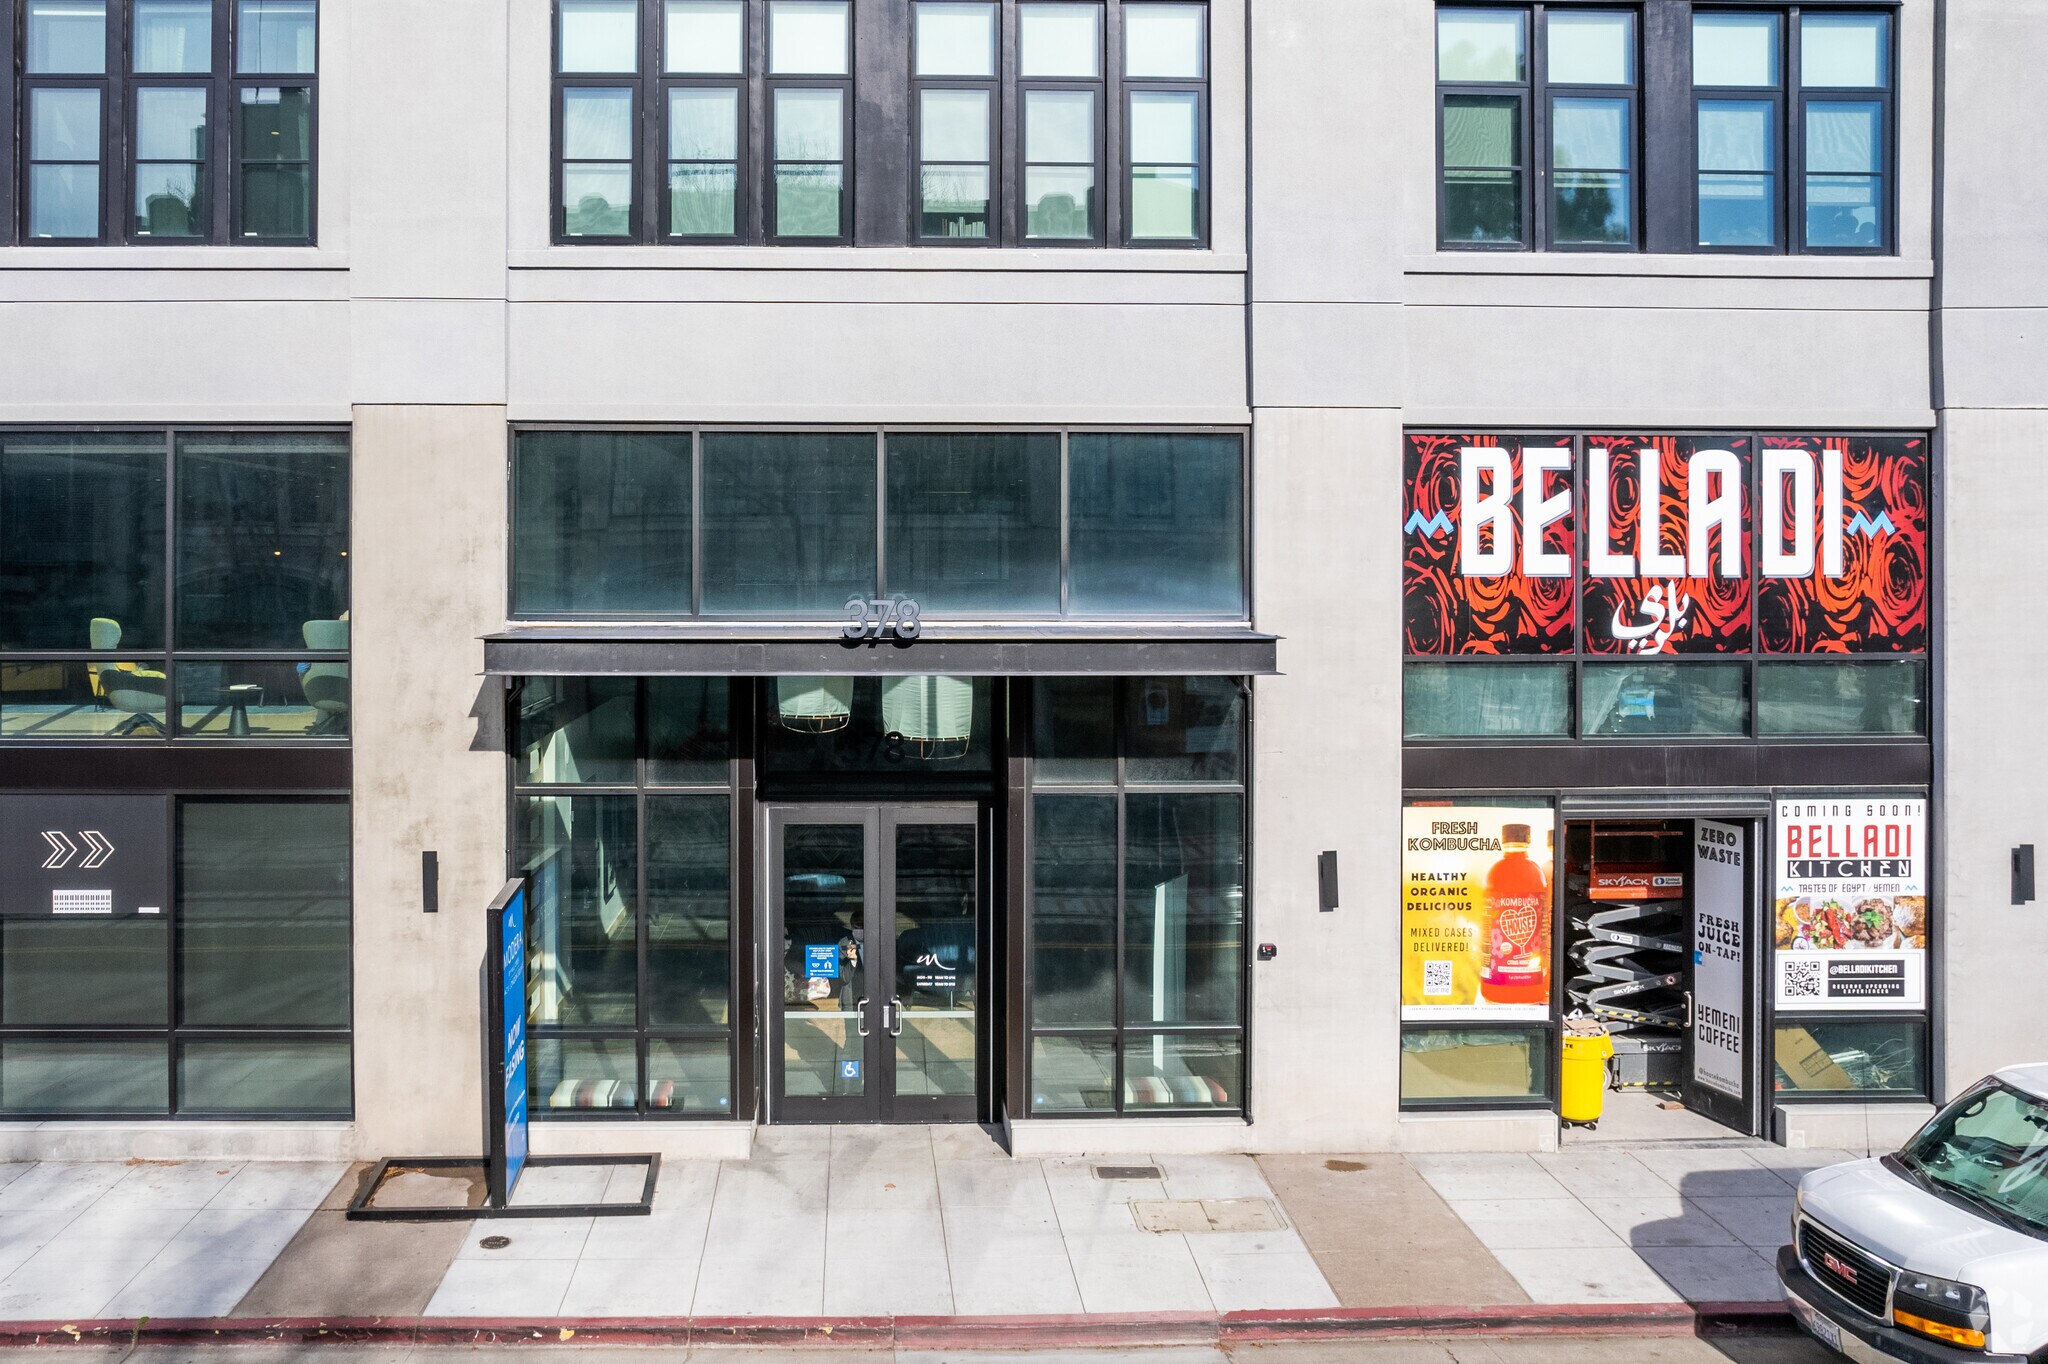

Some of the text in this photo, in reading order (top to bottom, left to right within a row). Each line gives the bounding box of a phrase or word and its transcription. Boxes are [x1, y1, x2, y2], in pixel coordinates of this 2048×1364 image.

[1461, 447, 1843, 577] BELLADI
[843, 599, 921, 639] 378
[1782, 804, 1921, 817] COMING SOON!
[1432, 821, 1478, 835] FRESH
[1700, 827, 1737, 847] ZERO
[1408, 838, 1501, 851] KOMBUCHA
[1787, 824, 1911, 858] BELLADI
[1697, 844, 1740, 867] WASTE
[1411, 872, 1467, 881] HEALTHY
[1789, 861, 1910, 877] KITCHEN
[1598, 876, 1649, 886] SKYJACK
[1799, 884, 1826, 893] TASTES
[1829, 884, 1838, 893] OF
[1842, 884, 1866, 893] EGYPT
[1873, 884, 1900, 893] YEMEN
[1410, 888, 1468, 896] ORGANIC
[1407, 902, 1472, 911] DELICIOUS
[1500, 897, 1539, 906] KOMBUCHA
[1506, 916, 1532, 936] HOUSE
[1699, 912, 1740, 933] FRESH
[1411, 928, 1473, 937] MIXED CASES
[1698, 925, 1740, 948] JUICE
[1413, 942, 1469, 952] DELIVERED!
[1698, 941, 1741, 962] ON-TAP!
[1829, 964, 1898, 975] @BELLADIKITCHEN
[1698, 1003, 1740, 1034] YEMENI
[1699, 1024, 1739, 1054] COFFEE
[505, 1039, 525, 1089] EASING
[1824, 1252, 1857, 1284] GMC
